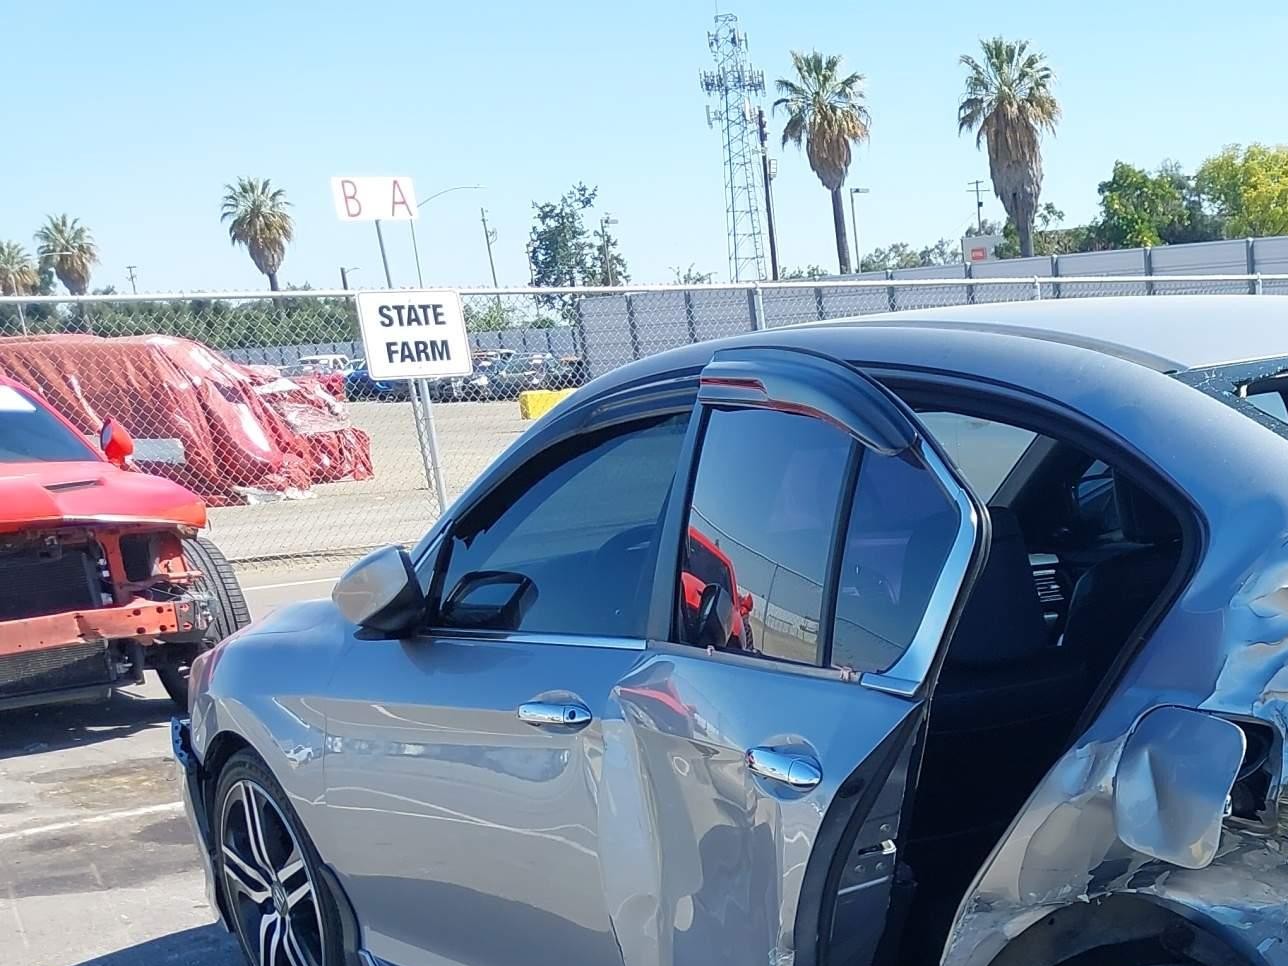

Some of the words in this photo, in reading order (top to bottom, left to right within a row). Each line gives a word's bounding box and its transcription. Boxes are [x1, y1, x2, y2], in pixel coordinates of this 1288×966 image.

[341, 179, 362, 218] B
[392, 179, 413, 217] A
[378, 303, 447, 328] STATE
[386, 339, 452, 364] FARM
